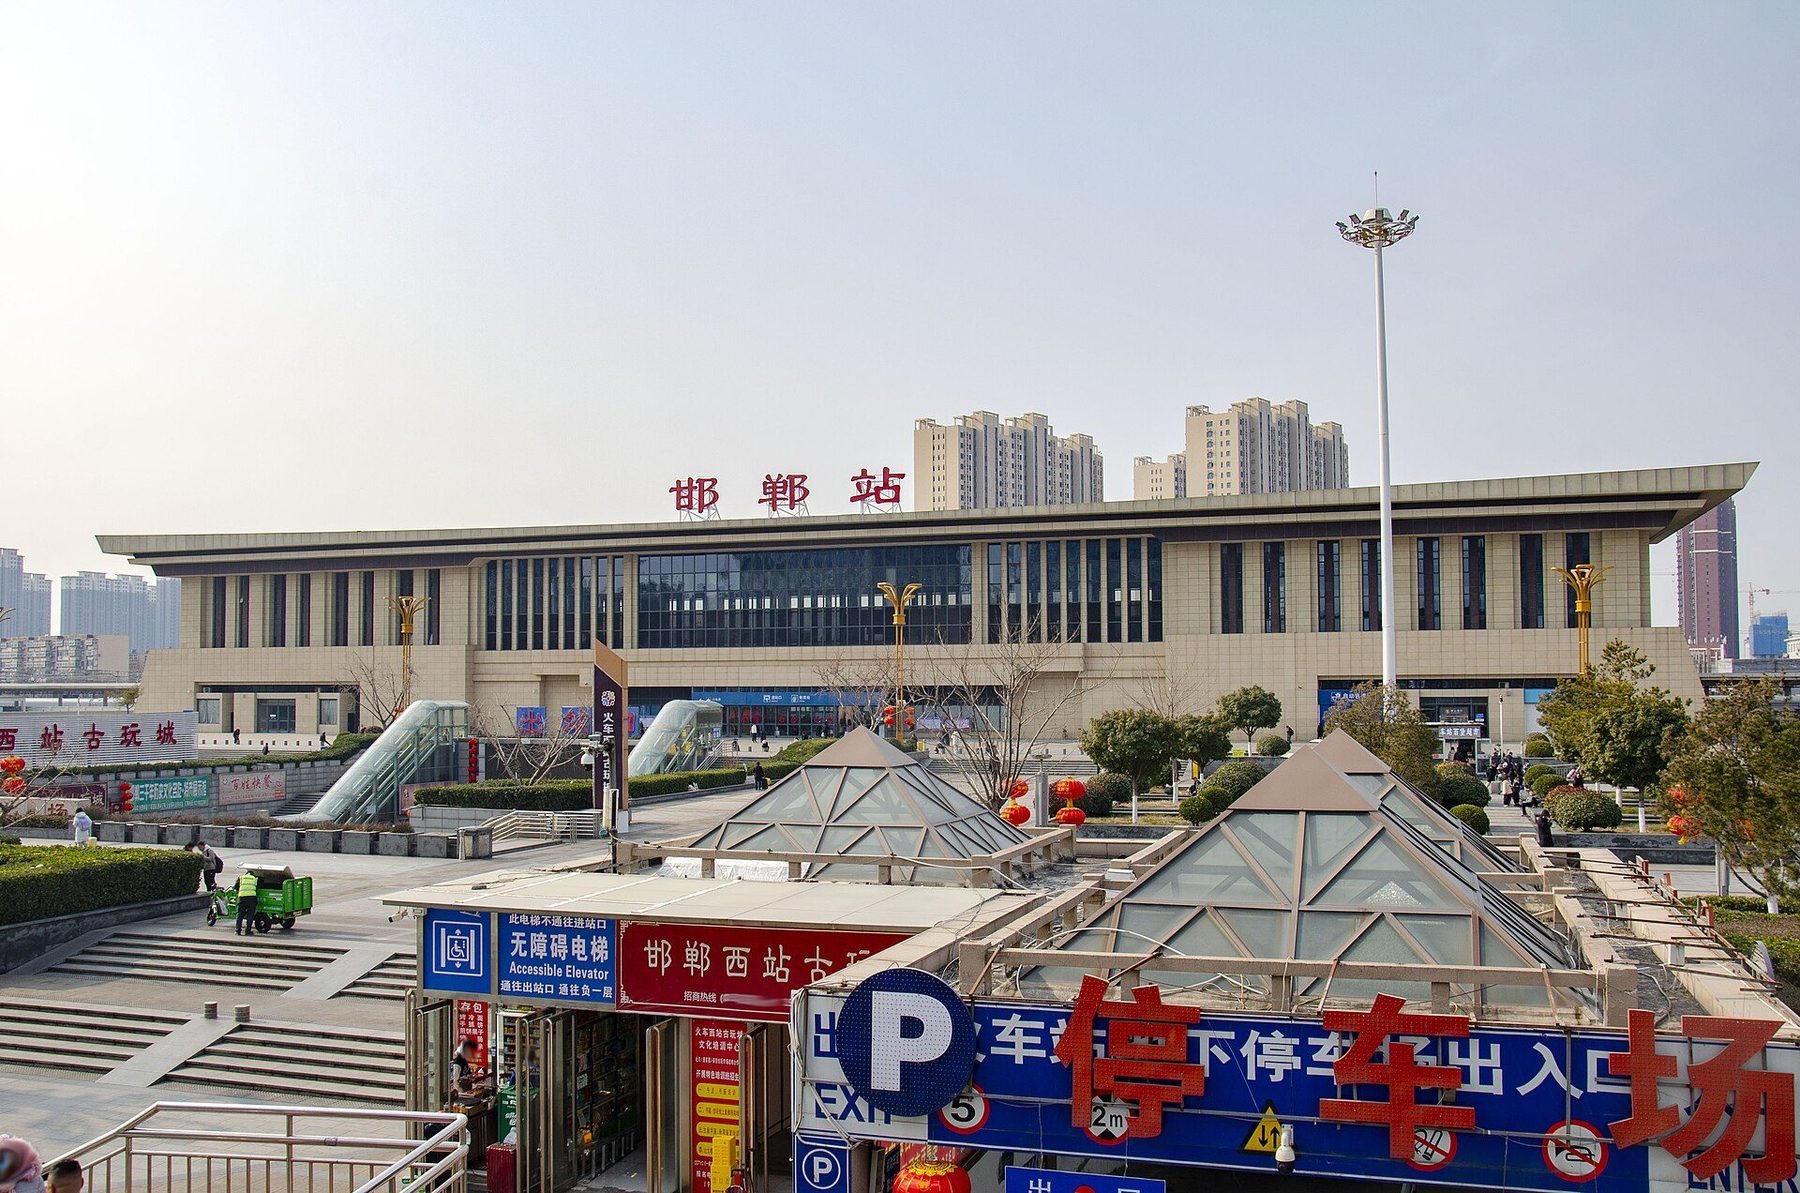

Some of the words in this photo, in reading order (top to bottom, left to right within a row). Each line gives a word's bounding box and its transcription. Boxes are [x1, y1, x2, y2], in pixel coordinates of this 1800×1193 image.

[669, 466, 906, 513] 邯郸站
[509, 914, 607, 929] 此电梯不通往进站口
[510, 932, 609, 962] 无障碍电梯
[509, 961, 563, 977] Accessible
[566, 965, 609, 980] Elevator
[500, 980, 554, 994] 通往出站口
[559, 983, 613, 998] 通往负一层
[684, 990, 716, 1004] 招商热线
[460, 1001, 483, 1014] 存包
[698, 1039, 739, 1052] 文化培训中心
[871, 990, 953, 1092] P
[1053, 974, 1795, 1184] 停车场
[951, 1096, 976, 1123] 5
[813, 1156, 833, 1183] P
